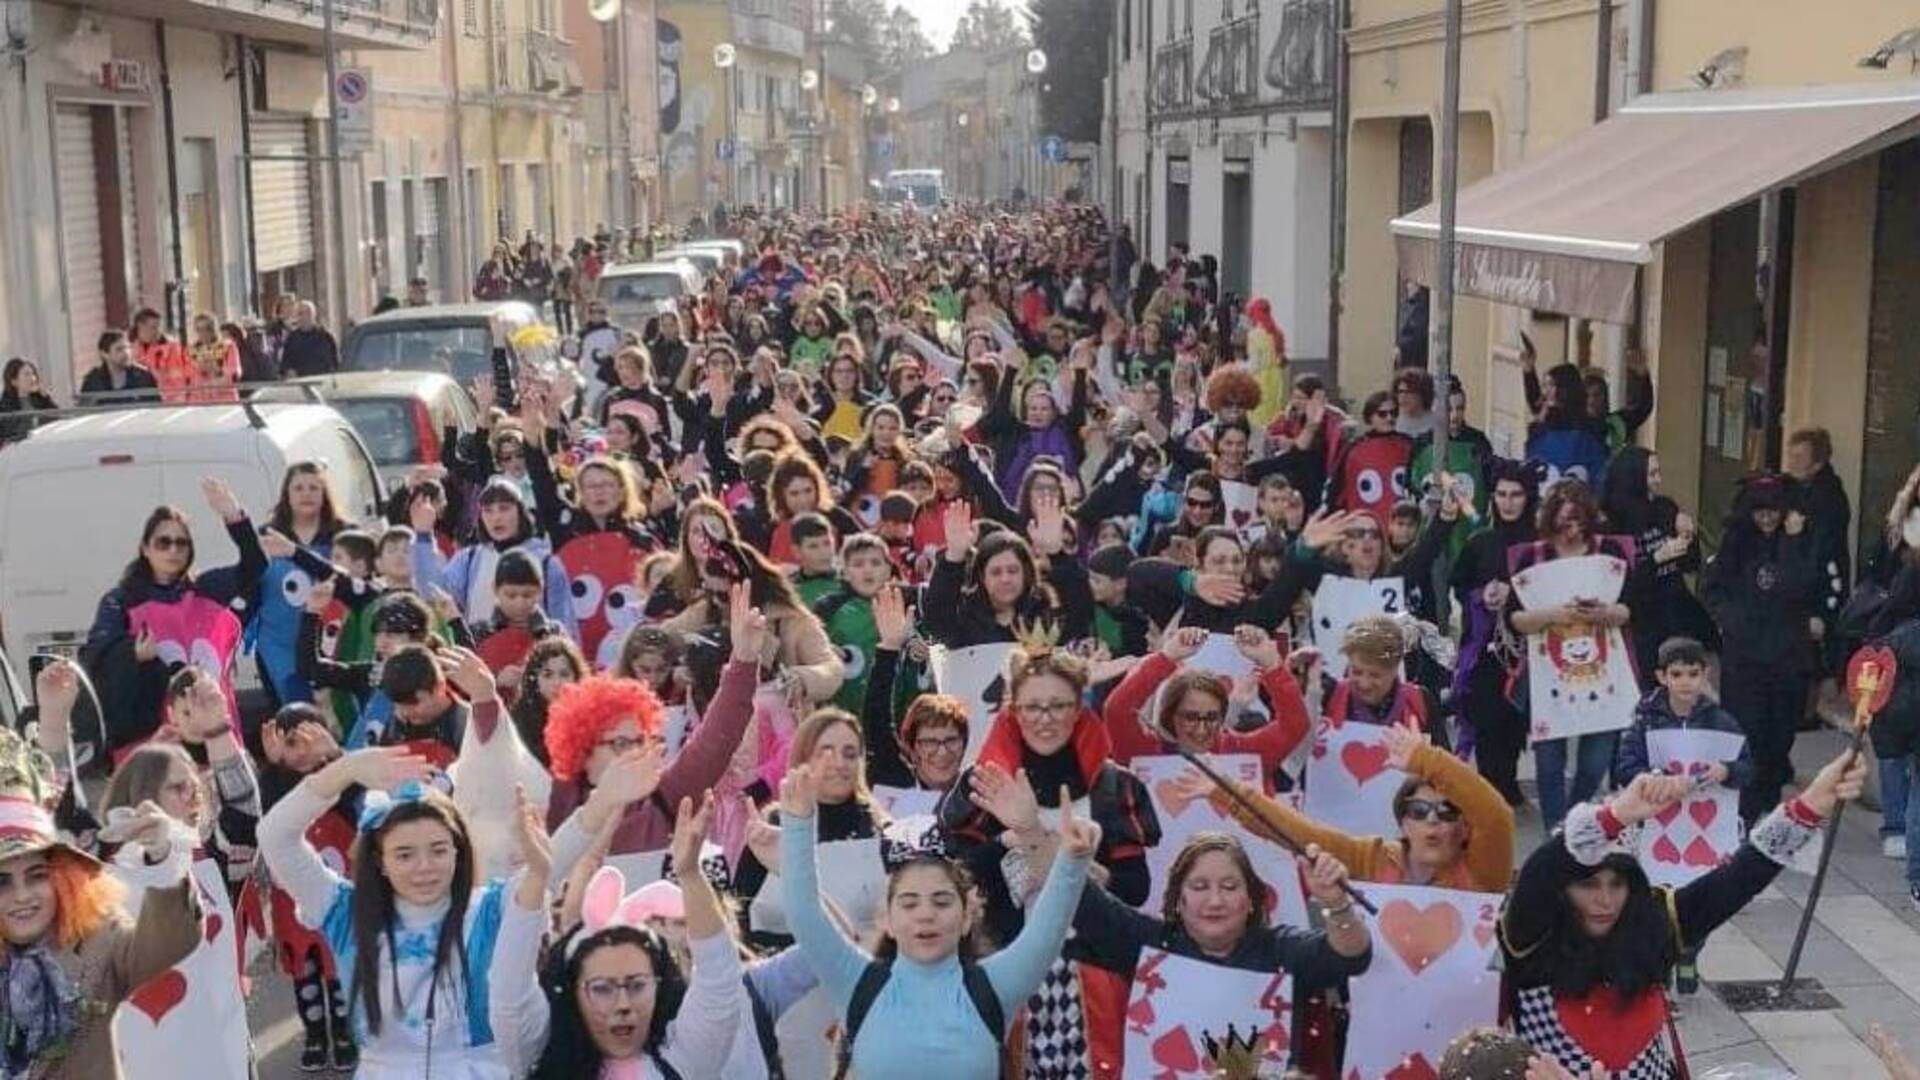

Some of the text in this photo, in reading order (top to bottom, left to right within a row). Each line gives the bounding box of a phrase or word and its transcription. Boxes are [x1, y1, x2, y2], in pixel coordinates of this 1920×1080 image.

[1382, 588, 1398, 613] 2
[1479, 904, 1494, 921] 2
[1260, 970, 1293, 1019] 4
